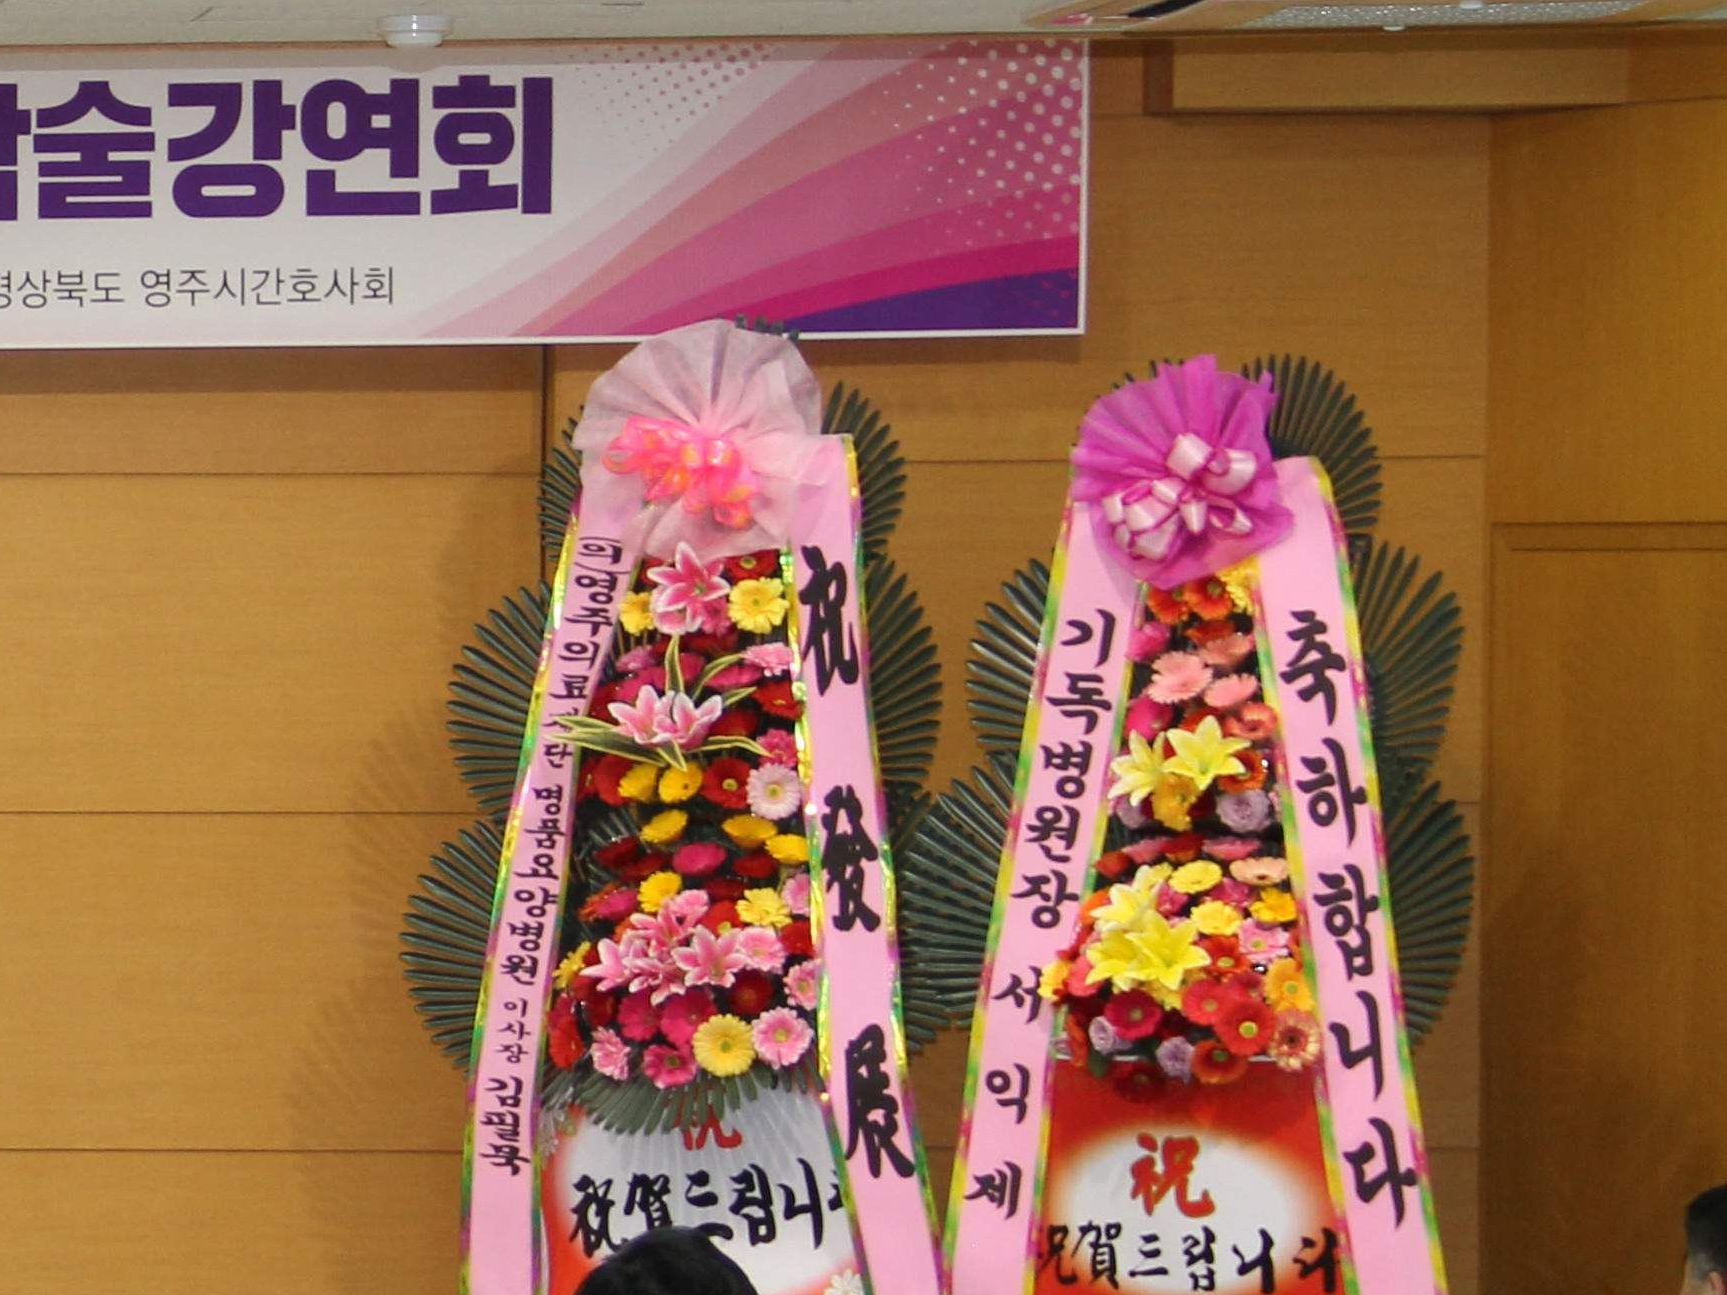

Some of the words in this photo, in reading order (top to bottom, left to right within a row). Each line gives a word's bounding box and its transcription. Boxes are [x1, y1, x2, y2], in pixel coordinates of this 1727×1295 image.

[139, 266, 394, 308] 영주시간호사회
[1013, 607, 1117, 930] 기독병원장
[499, 784, 566, 987] 명품요양병원
[1277, 607, 1419, 1230] 축하합니다
[495, 997, 532, 1065] 이사장
[1130, 1131, 1216, 1219] 祝
